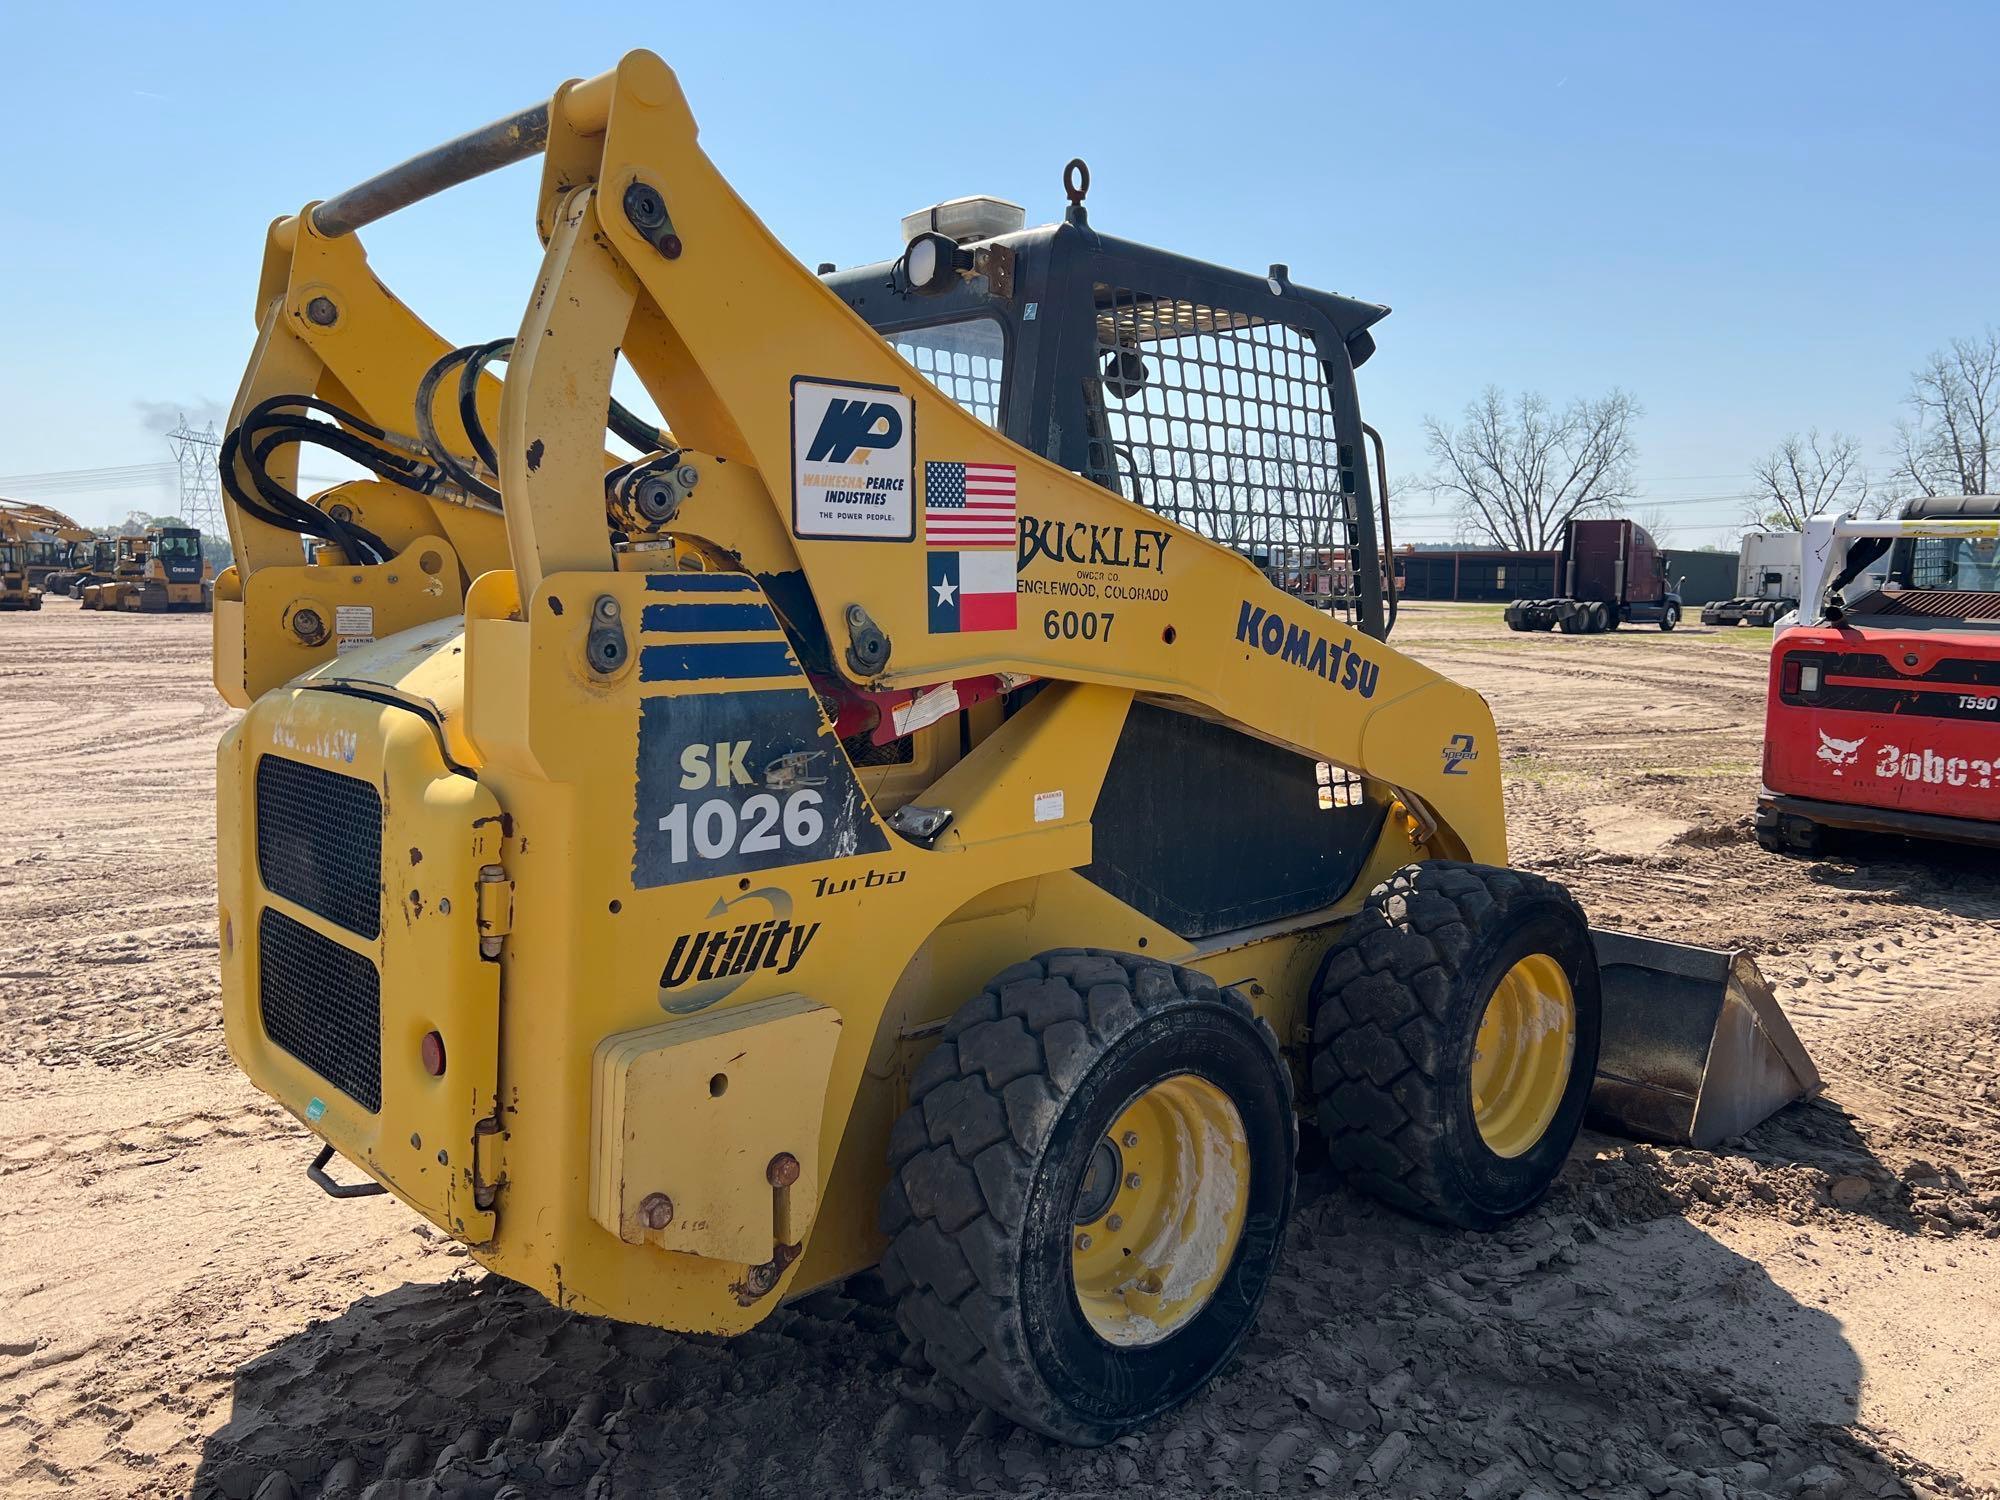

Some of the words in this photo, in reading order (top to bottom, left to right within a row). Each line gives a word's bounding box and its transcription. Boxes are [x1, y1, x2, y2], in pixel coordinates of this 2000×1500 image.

[802, 473, 904, 491] WAUKESHA-PEARCE
[825, 490, 887, 505] INDUSTRIES
[819, 511, 834, 519] THE
[837, 512, 863, 520] POWER
[1017, 516, 1173, 574] BUCKLEY
[172, 566, 196, 574] DEERE
[1016, 579, 1099, 599] ENGLEWOOD,
[1104, 585, 1169, 602] COLORADO
[1044, 609, 1115, 643] 6007
[1235, 600, 1380, 699] KOMATSU
[1959, 695, 1998, 711] T590
[680, 740, 754, 790] SK
[1441, 747, 1479, 761] Speed
[1443, 734, 1474, 775] 2
[659, 789, 825, 864] 1026
[811, 869, 907, 898] Turbo
[659, 919, 822, 989] Utility
